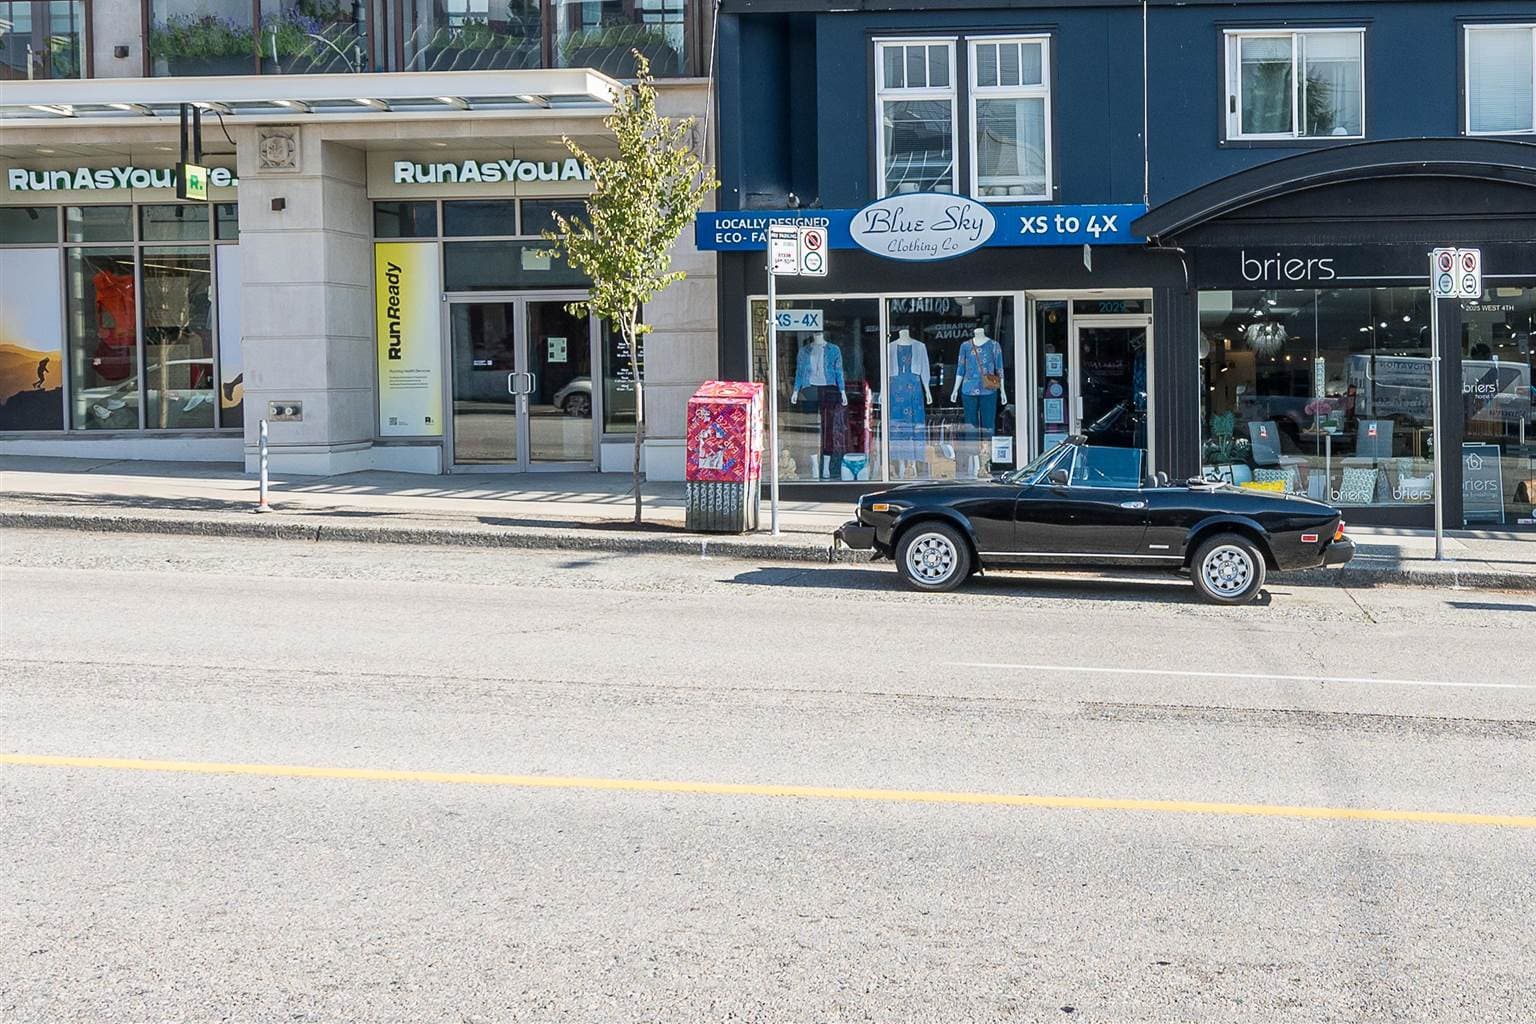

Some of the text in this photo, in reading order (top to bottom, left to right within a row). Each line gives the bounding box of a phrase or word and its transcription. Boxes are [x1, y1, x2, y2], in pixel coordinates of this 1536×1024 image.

[715, 219, 766, 230] LOCALLY
[862, 204, 984, 241] Blue Sky
[1020, 213, 1118, 238] XS to 4X
[715, 232, 767, 243] ECO- FA
[887, 238, 959, 257] Clothing Co
[1241, 250, 1335, 281] briers
[385, 261, 402, 360] RunReady
[1099, 301, 1126, 313] 2029
[801, 313, 818, 326] 4X
[1463, 381, 1496, 393] briers
[1331, 487, 1369, 500] briers
[1393, 487, 1431, 500] briers
